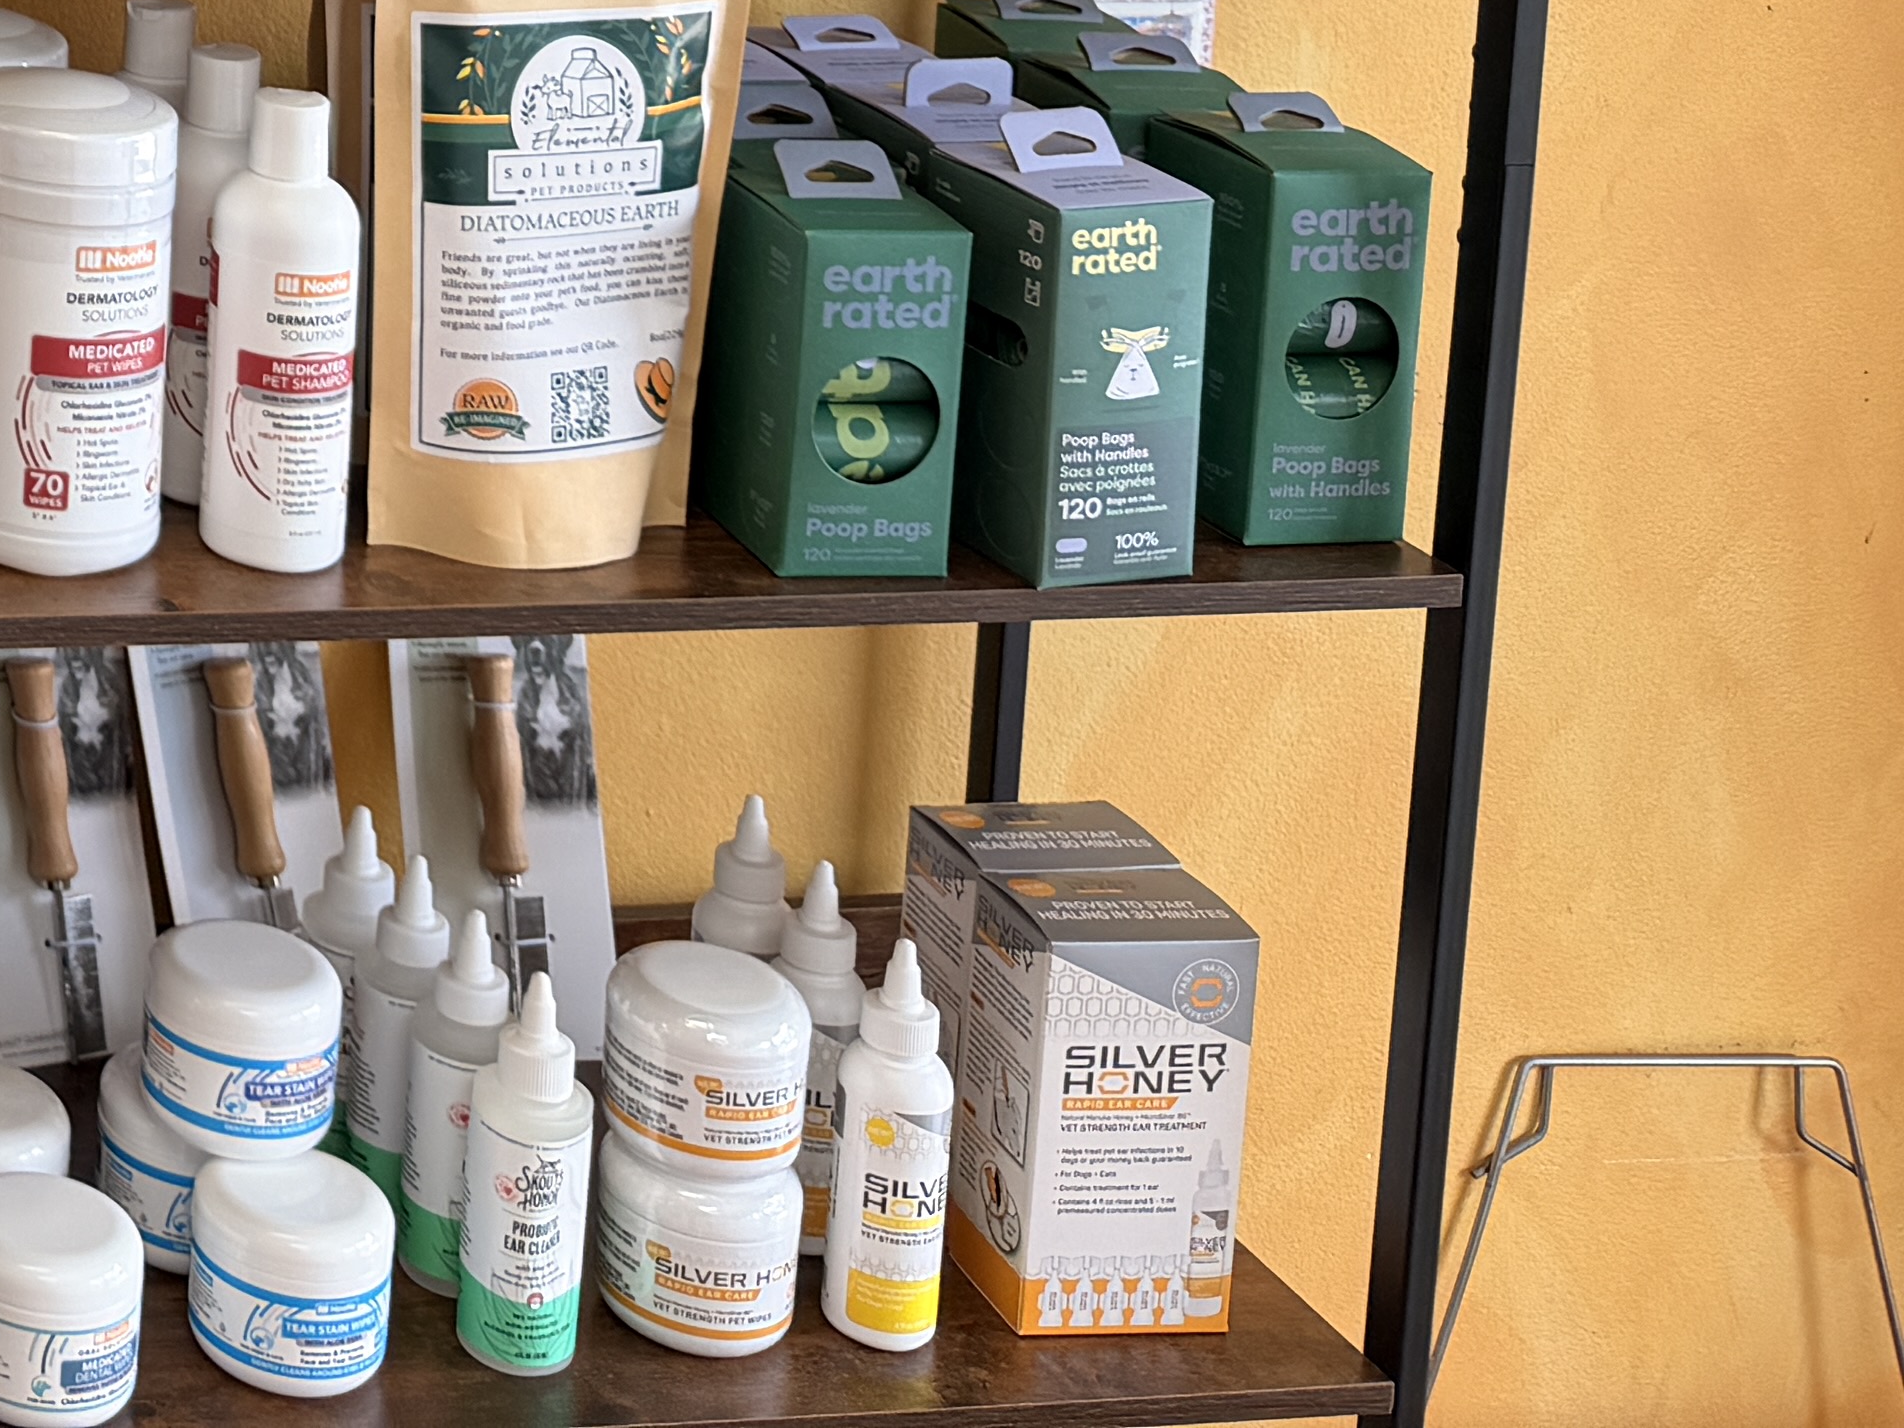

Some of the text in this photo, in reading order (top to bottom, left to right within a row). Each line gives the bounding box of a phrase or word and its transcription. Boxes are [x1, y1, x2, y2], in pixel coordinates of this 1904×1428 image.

[503, 155, 650, 181] solutions
[532, 182, 624, 197] PET PRODUCTS
[460, 200, 680, 234] DIATOMACEOUS EARTH
[1291, 199, 1413, 237] earth
[1072, 219, 1157, 248] earth
[823, 256, 953, 294] earth
[66, 286, 158, 307] DERMATOLOGY
[82, 305, 147, 323] SOLUTIONS
[441, 319, 481, 331] organic
[484, 317, 503, 330] and
[68, 338, 153, 362] MEDICATED
[463, 394, 509, 410] RAW
[1061, 446, 1149, 463] with Handles
[1060, 465, 1089, 478] Sacs
[1108, 462, 1153, 476] crottes
[1059, 473, 1156, 493] avec poignées
[1058, 497, 1101, 521] 120
[805, 518, 931, 539] Poop Bags
[1115, 532, 1159, 549] 100%
[1052, 901, 1195, 909] PROVEN TO START
[1037, 910, 1230, 920] HEALING IN 30 MINUTES
[1063, 1044, 1227, 1068] SILVER
[1063, 1068, 1225, 1094] HONEY
[1066, 1098, 1169, 1109] RAPID EAR CARE
[286, 1322, 315, 1334] TEAR
[728, 1316, 745, 1325] PET
